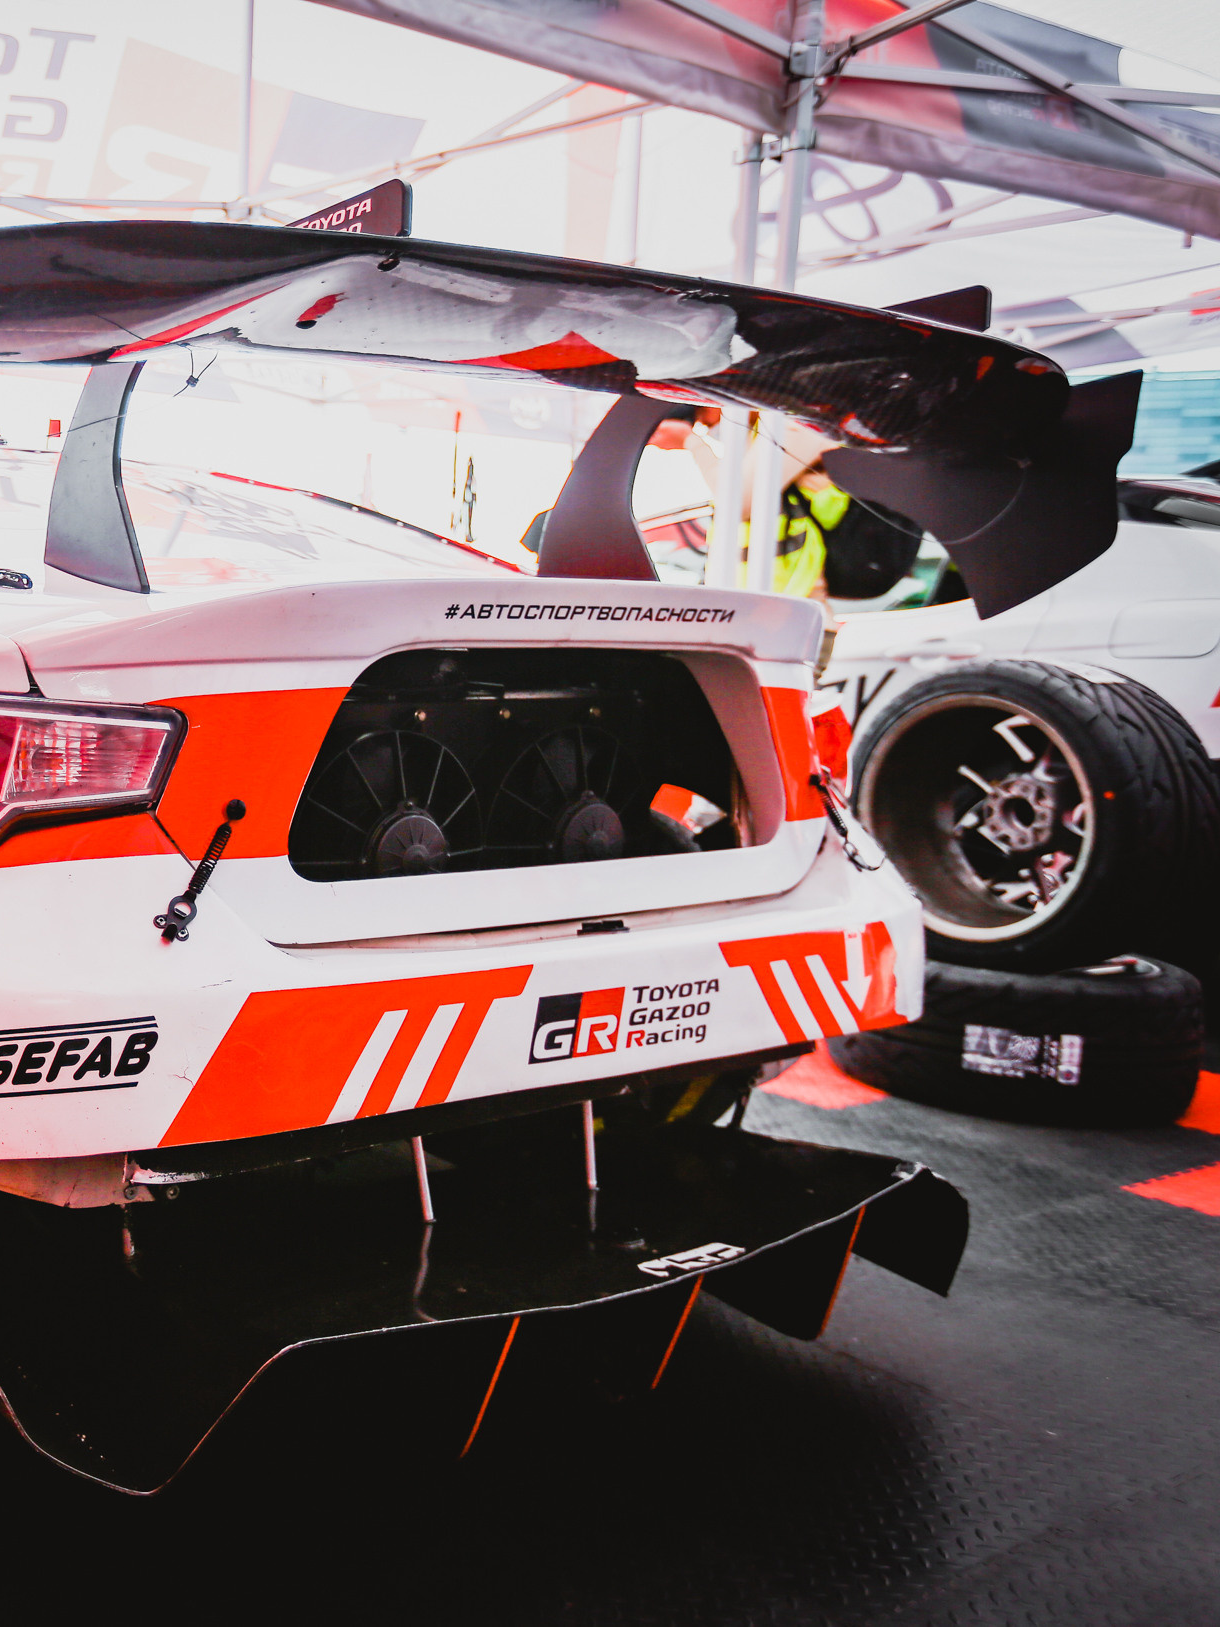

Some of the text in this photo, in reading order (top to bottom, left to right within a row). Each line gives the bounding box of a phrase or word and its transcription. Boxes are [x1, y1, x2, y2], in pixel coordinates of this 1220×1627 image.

[445, 604, 735, 623] #АВТОСПОРТВОПАСНОСТИ
[632, 978, 720, 1003] TOYOTA
[629, 1001, 711, 1026] GAZOO
[532, 1014, 618, 1060] GR
[625, 1024, 706, 1048] Racing
